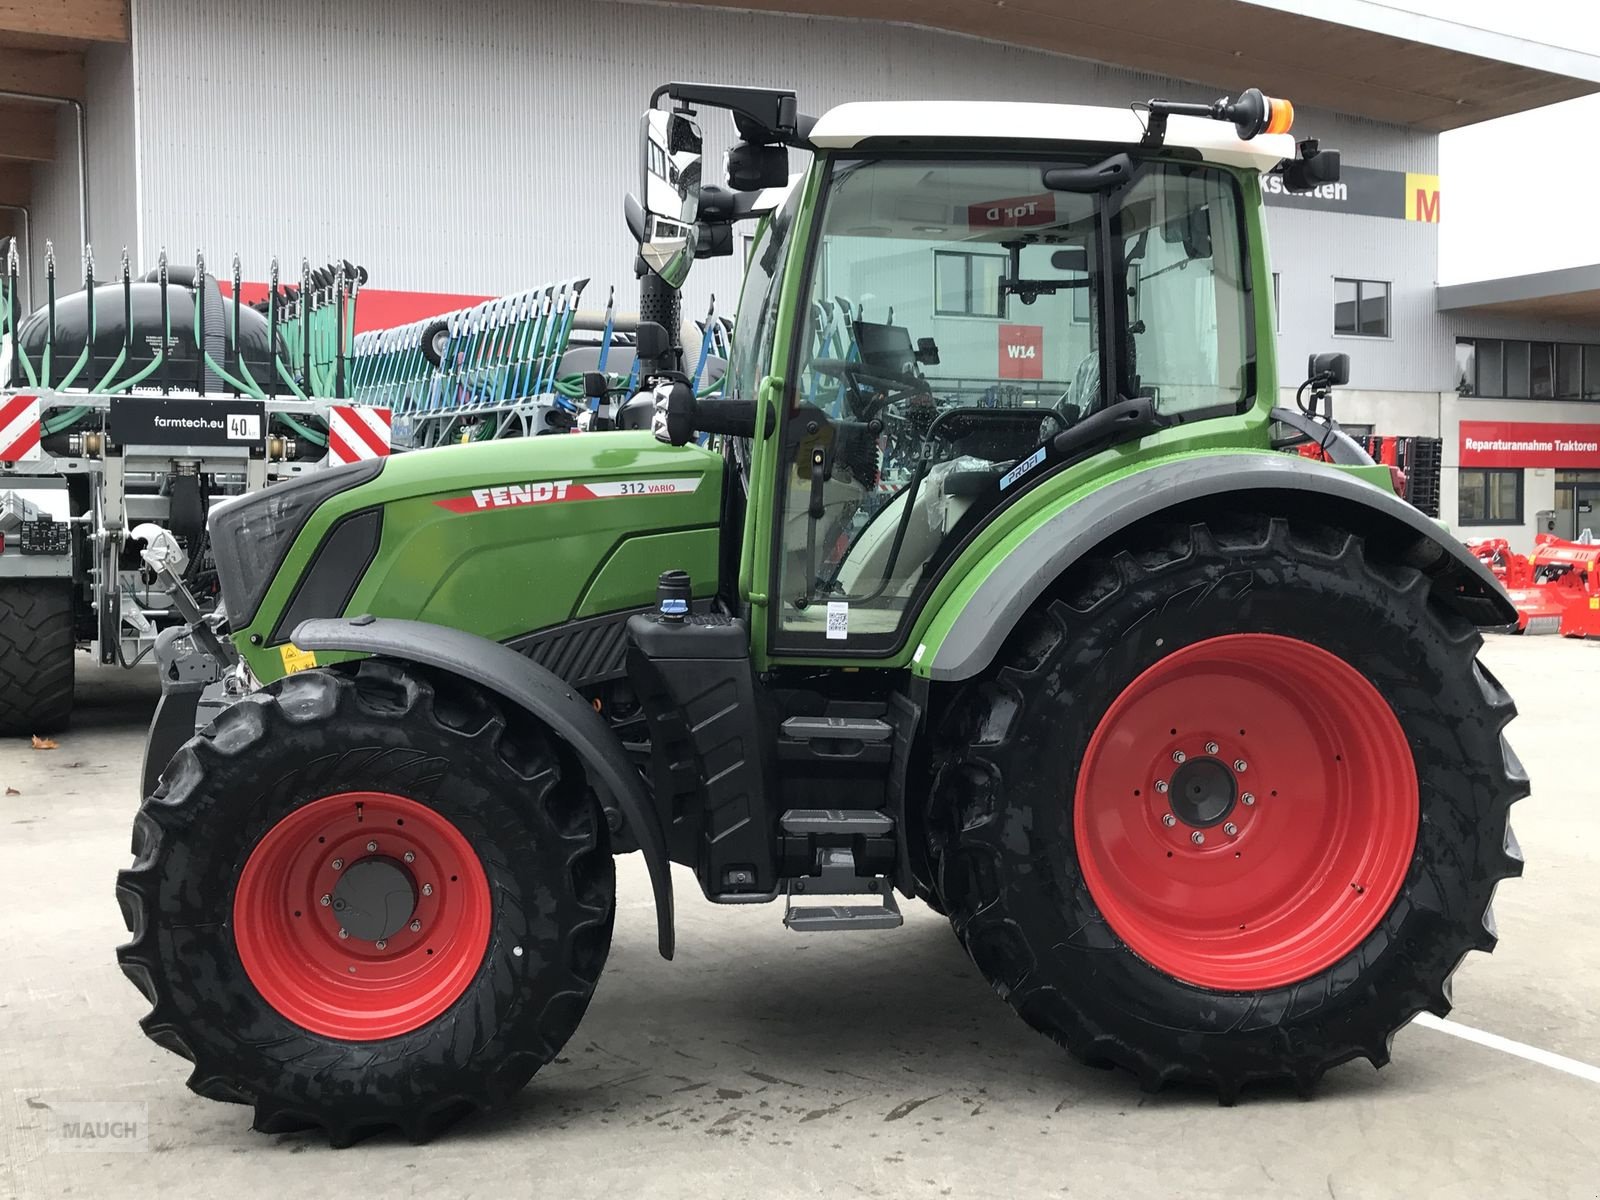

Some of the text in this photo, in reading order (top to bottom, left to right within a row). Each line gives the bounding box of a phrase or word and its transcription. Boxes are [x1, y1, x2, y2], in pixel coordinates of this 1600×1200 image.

[1007, 345, 1036, 359] W14
[154, 415, 224, 429] farmtech.eu
[231, 418, 247, 436] 40
[1465, 438, 1598, 452] Reparaturannahme Traktoren
[1008, 454, 1038, 483] PROFI
[471, 479, 675, 508] FENDT 312 VARIO
